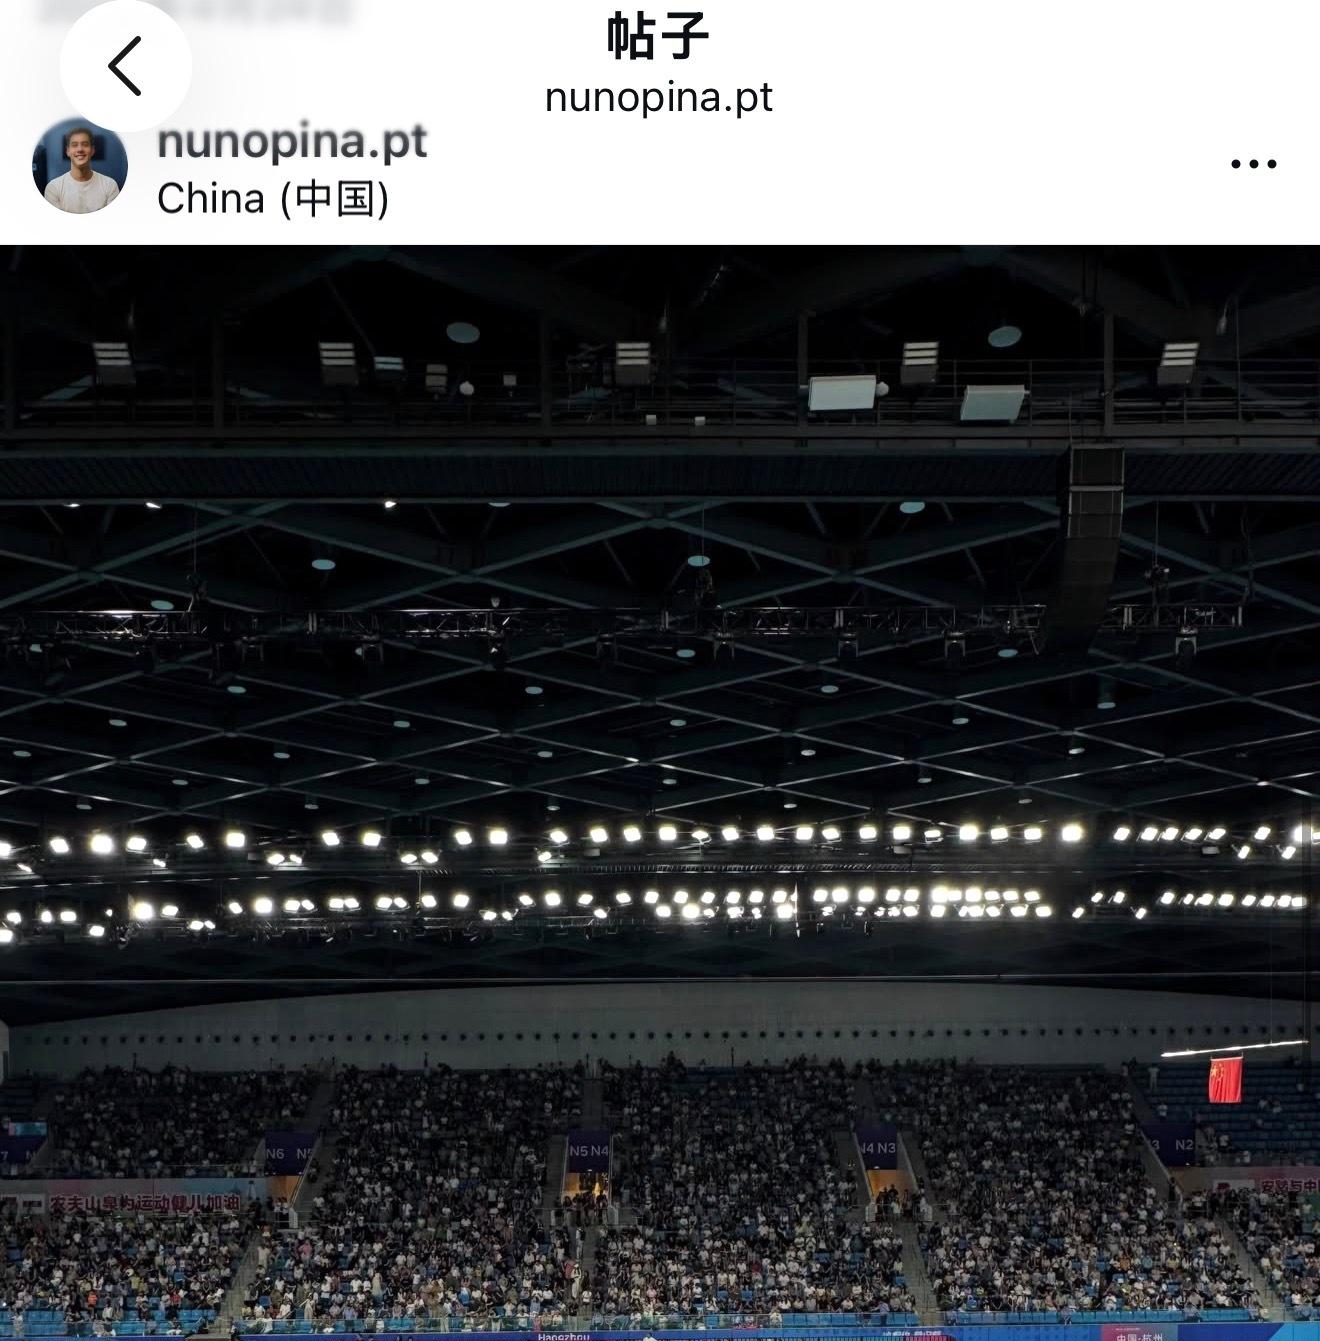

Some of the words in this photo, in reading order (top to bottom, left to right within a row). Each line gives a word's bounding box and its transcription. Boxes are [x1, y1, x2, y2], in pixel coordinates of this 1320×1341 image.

[878, 1142, 896, 1154] N3
[1175, 1139, 1194, 1150] N2
[266, 1148, 285, 1160] N6
[569, 1145, 588, 1157] N5
[591, 1145, 609, 1156] N4
